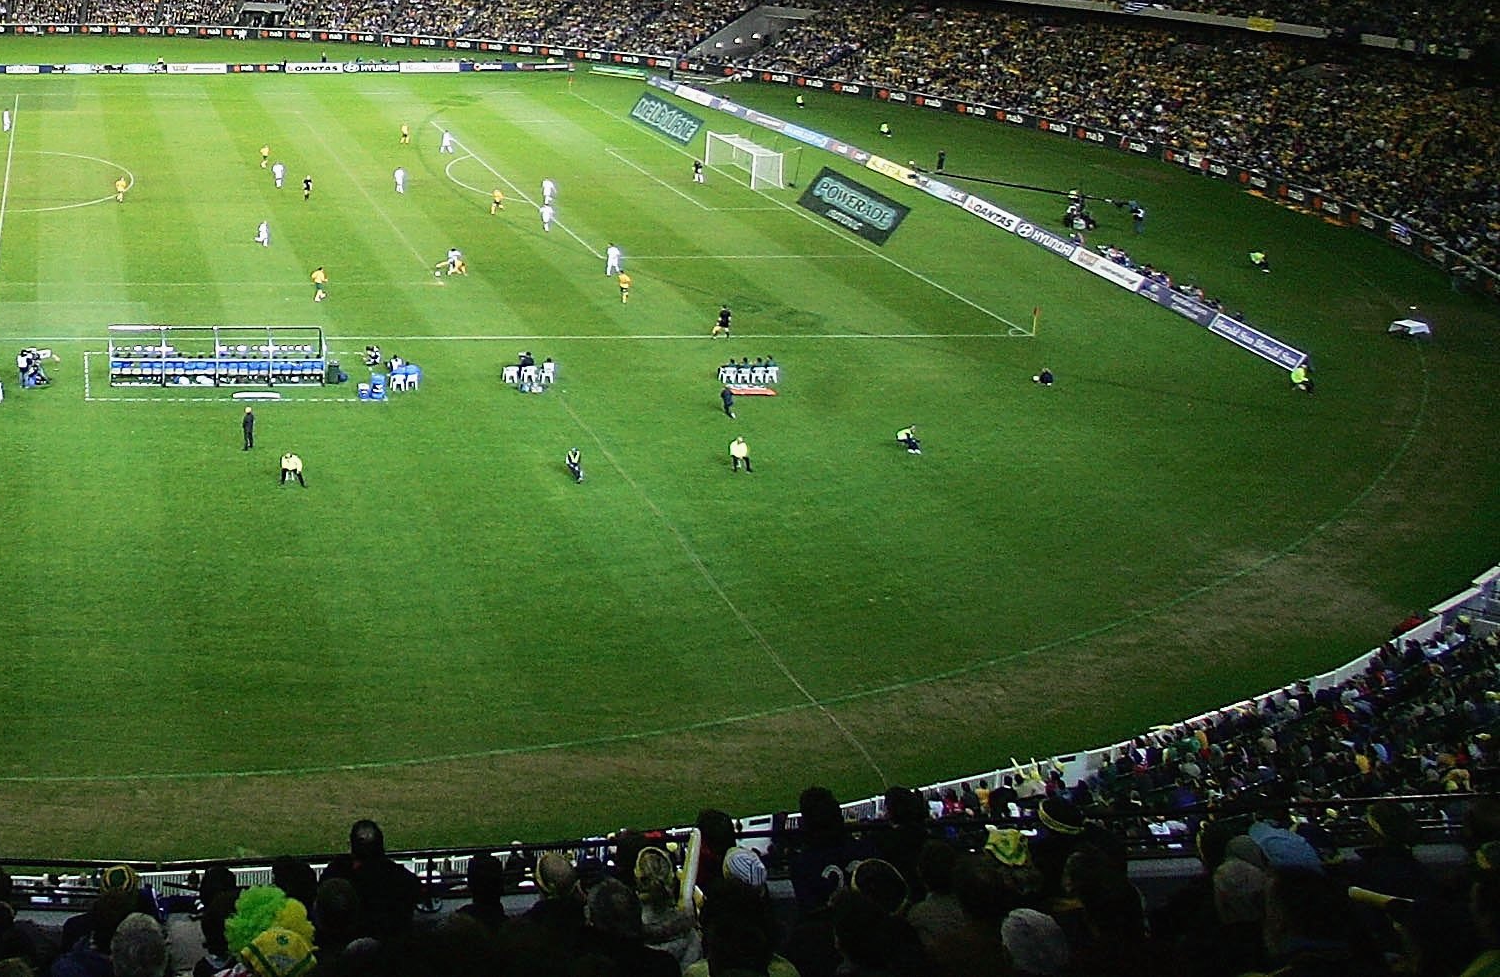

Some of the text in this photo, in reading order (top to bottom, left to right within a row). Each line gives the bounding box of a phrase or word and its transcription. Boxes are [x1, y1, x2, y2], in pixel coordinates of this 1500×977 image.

[25, 25, 37, 33] nab
[56, 25, 70, 33] nab
[89, 25, 102, 33] nab
[117, 26, 131, 34] nab
[207, 27, 220, 35] nab
[296, 31, 310, 39] nab
[328, 32, 342, 40] nab
[359, 34, 374, 42] nab
[392, 36, 406, 44] nab
[419, 38, 435, 46] nab
[456, 40, 470, 49] nab
[488, 43, 502, 51] nab
[517, 45, 533, 54] nab
[549, 48, 563, 56] nab
[584, 51, 601, 60] nab
[622, 55, 639, 65] nab
[655, 59, 671, 68] nab
[295, 64, 338, 72] QANTAS
[360, 63, 400, 72] HYUNDAI
[772, 74, 788, 83] nab
[806, 79, 823, 88] nab
[842, 84, 859, 94] nab
[890, 92, 907, 101] nab
[925, 98, 942, 108] nab
[967, 105, 986, 116] nab
[631, 96, 699, 142] MELBOURNE
[1006, 113, 1023, 124] nab
[1050, 123, 1067, 133] nab
[1085, 131, 1104, 142] nab
[1130, 142, 1147, 153] nab
[1211, 163, 1228, 175] nab
[818, 179, 893, 224] POWERADE
[973, 204, 1015, 229] QANTAS
[1031, 230, 1076, 257] HYUNDAI
